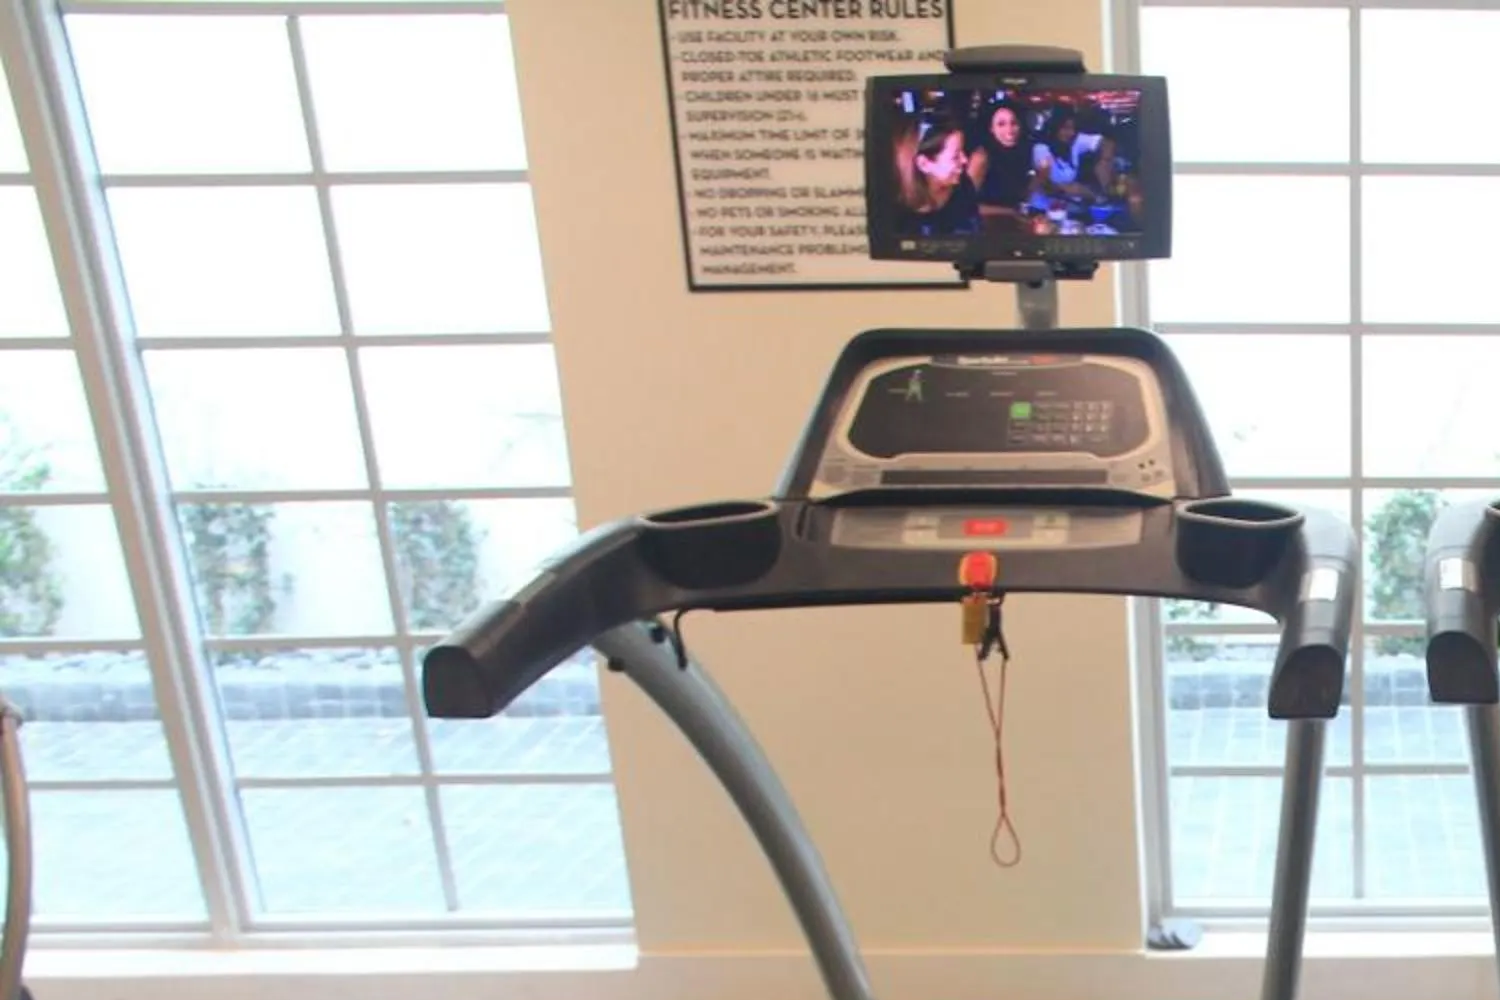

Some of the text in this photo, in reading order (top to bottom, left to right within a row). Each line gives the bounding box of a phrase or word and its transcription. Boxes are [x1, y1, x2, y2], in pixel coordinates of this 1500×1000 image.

[669, 0, 944, 19] FITNESS CENTER RULES
[679, 31, 702, 42] USE
[707, 30, 765, 42] FACILITY
[771, 30, 785, 41] AT
[790, 30, 826, 41] YOUR
[831, 30, 866, 42] OWN
[770, 50, 832, 62] ATHLETIC
[836, 50, 913, 61] FOOTWEAR
[682, 71, 734, 82] PROPER
[739, 71, 783, 82] ATTIRE
[685, 91, 752, 102] CHILDREN
[757, 91, 802, 101] UNDER
[823, 90, 859, 101] MUST
[686, 111, 774, 122] SUPERVISION
[690, 131, 755, 141] MAXIMUM
[759, 130, 789, 141] TIME
[794, 130, 827, 141] LIMIT
[832, 129, 848, 140] OF
[691, 150, 731, 161] WHEN
[735, 150, 799, 161] SOMEONE
[805, 150, 816, 160] IS
[695, 188, 715, 198] NO
[720, 188, 787, 199] DROPPING
[791, 187, 810, 198] OR
[697, 208, 717, 218] NO
[721, 207, 750, 218] PETS
[755, 207, 773, 218] OR
[778, 206, 840, 217] SMOKING
[729, 226, 764, 237] YOUR
[824, 225, 868, 236] PLEAS
[701, 244, 794, 256] MAINTENANCE
